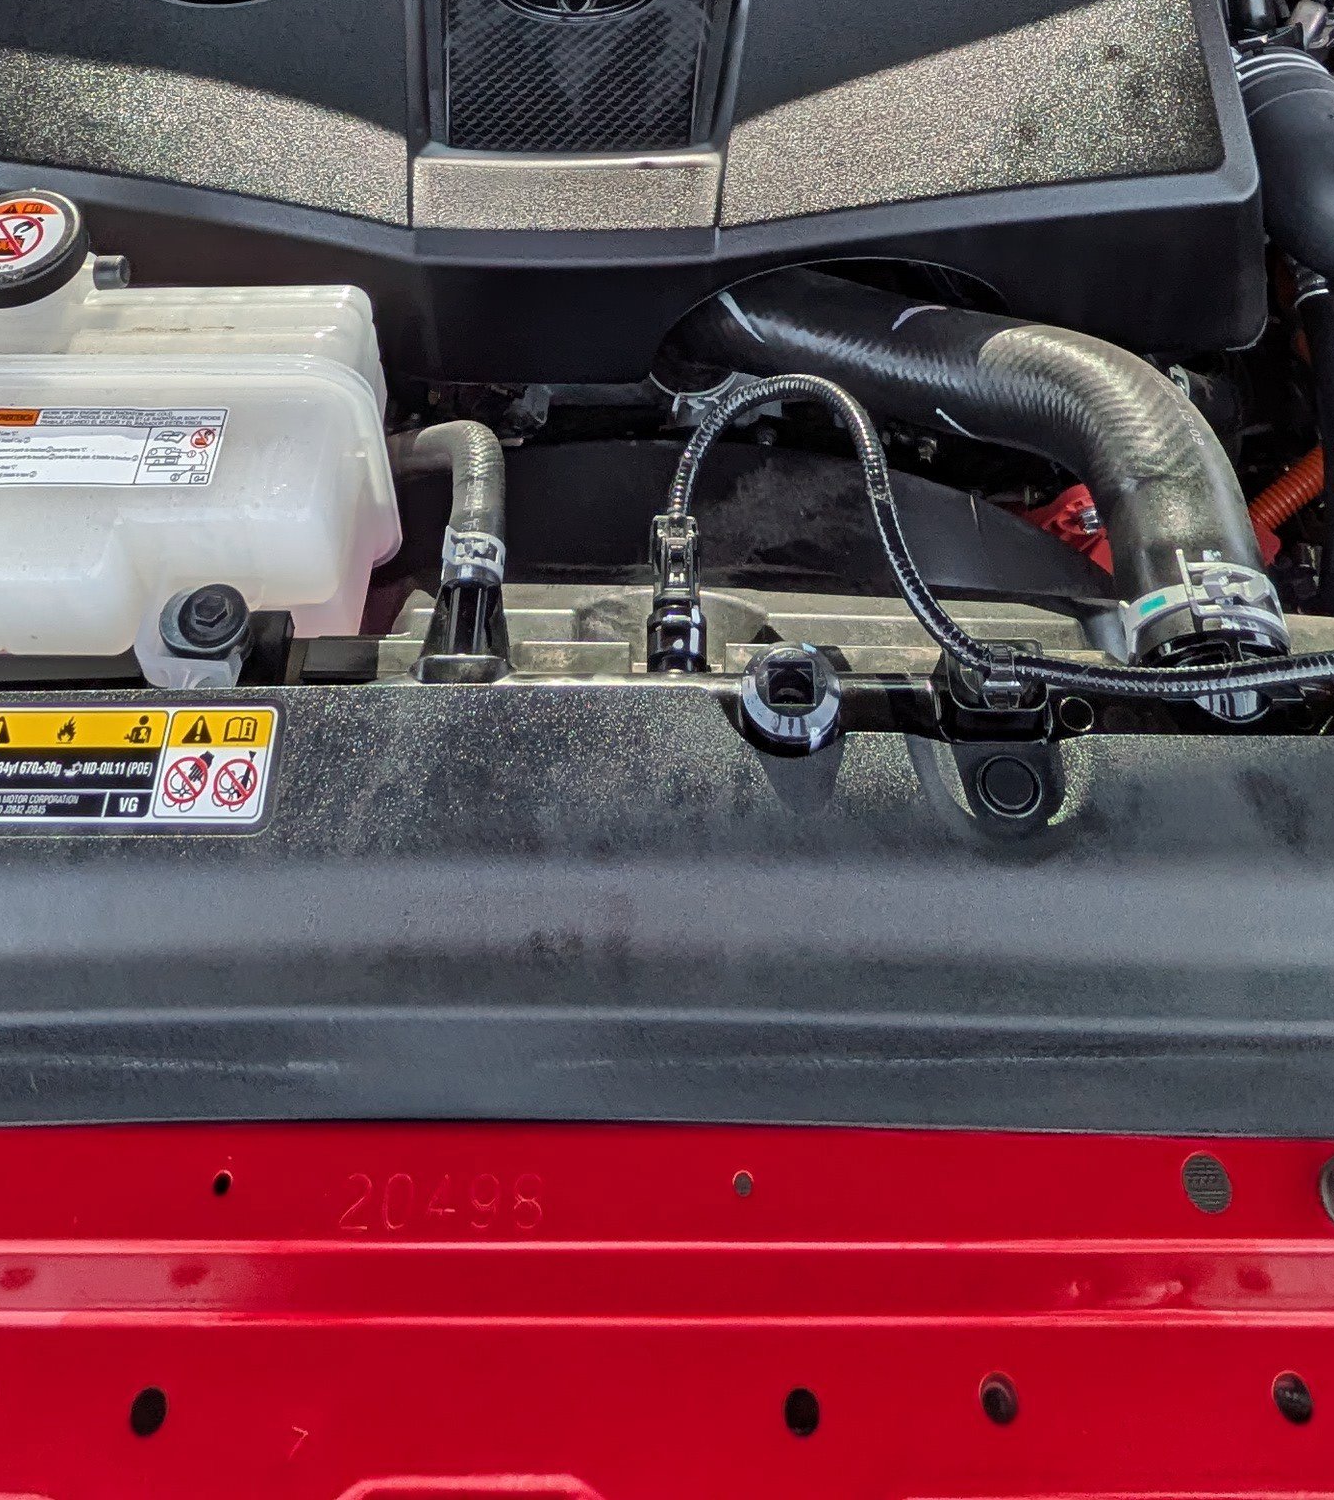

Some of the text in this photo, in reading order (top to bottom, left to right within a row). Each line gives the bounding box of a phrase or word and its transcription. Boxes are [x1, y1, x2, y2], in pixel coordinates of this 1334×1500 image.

[20, 761, 62, 777] 670±30g
[1, 794, 29, 804] MOTOR
[28, 795, 80, 804] CORPORATION
[119, 797, 140, 813] VG
[339, 1172, 543, 1230] 20498
